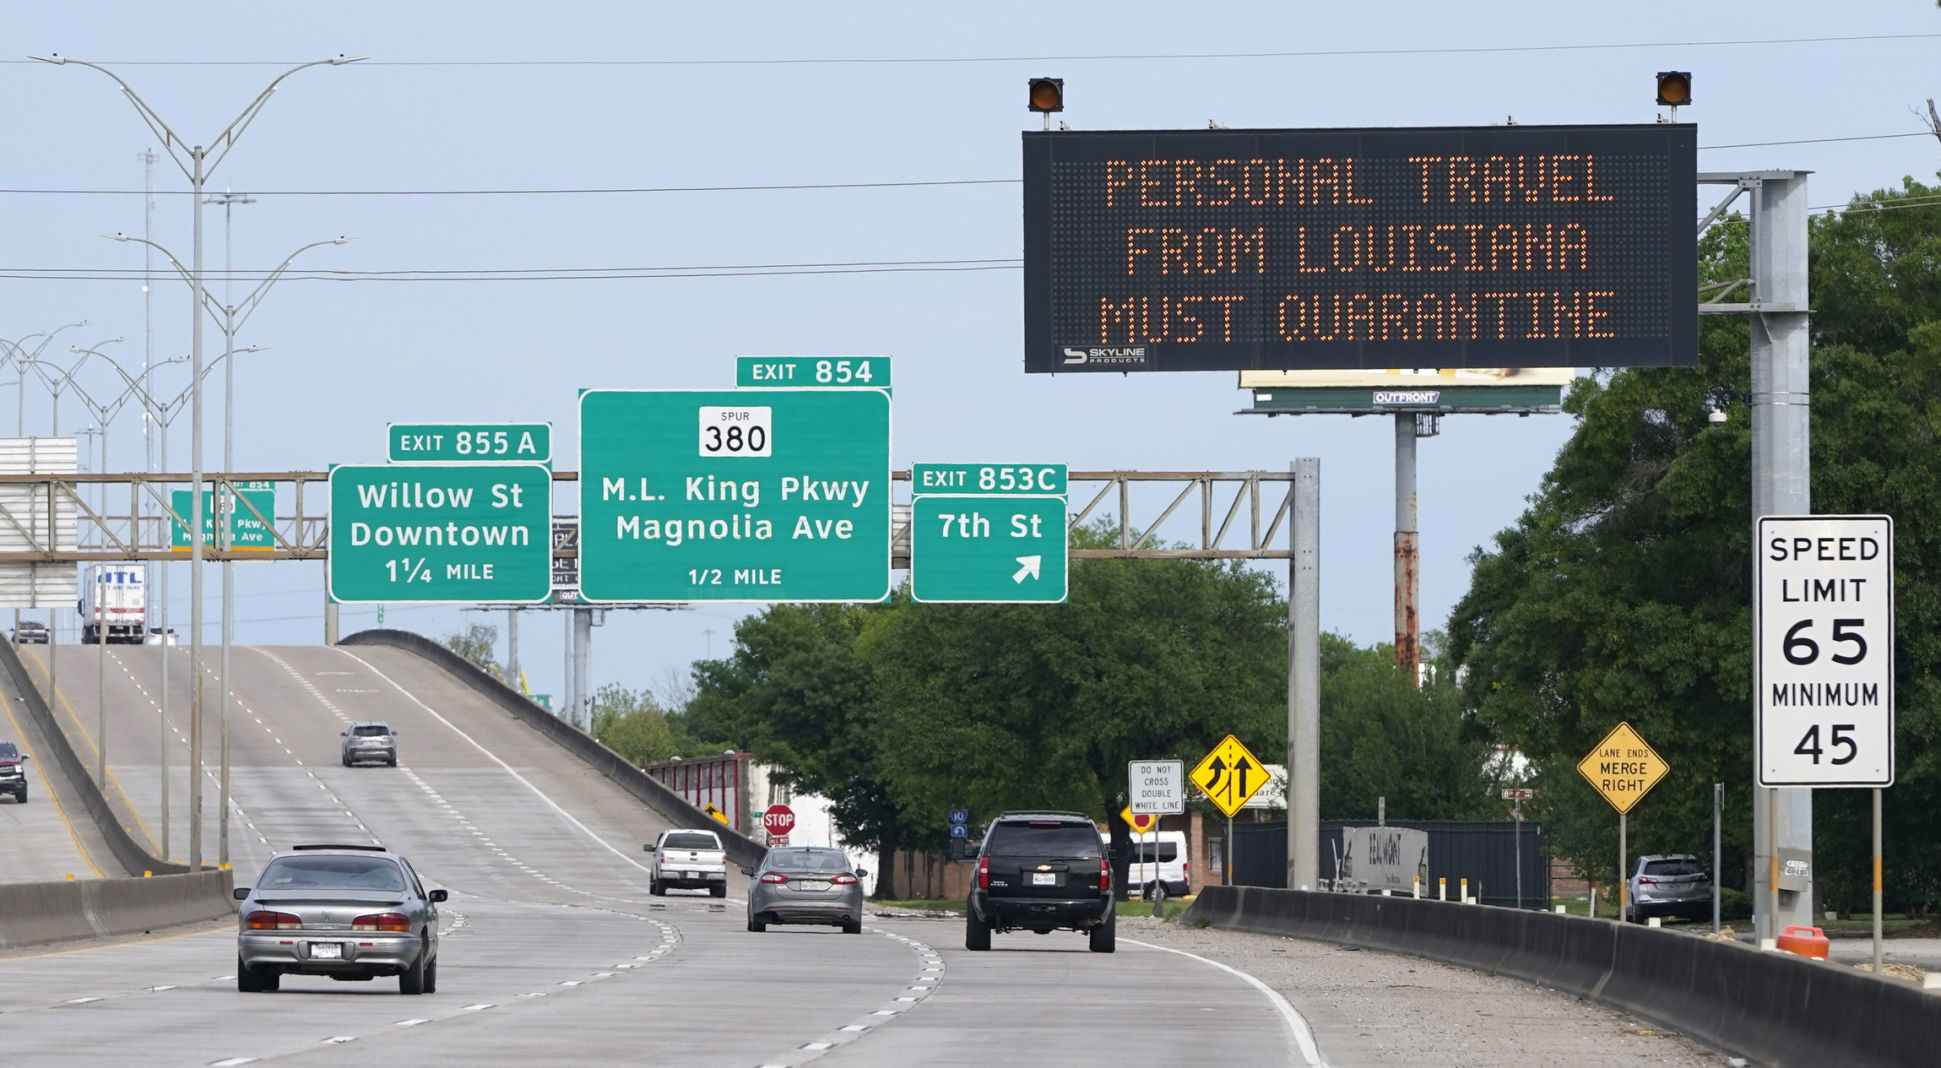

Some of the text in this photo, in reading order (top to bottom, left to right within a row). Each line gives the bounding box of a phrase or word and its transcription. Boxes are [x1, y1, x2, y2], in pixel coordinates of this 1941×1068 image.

[1107, 155, 1613, 206] PERSONAL TRAVEL
[1128, 224, 1586, 275] FROM LOUISIANA
[1101, 292, 1614, 343] MUST QUARANTINE
[1089, 347, 1145, 357] SKYLINE
[753, 361, 872, 382] EXIT 854
[1376, 391, 1436, 403] OUTFRONT
[722, 412, 749, 421] SPUR
[402, 432, 536, 454] EXIT 855 A
[706, 426, 765, 451] 380
[924, 468, 1055, 490] EXIT 853C
[358, 482, 522, 508] Willow St
[603, 475, 869, 507] M.L. King Pkwy
[352, 522, 528, 546] Downtown
[617, 514, 852, 546] Magnolia Ave
[939, 512, 1041, 537] 7th St
[241, 532, 262, 541] Ave
[1771, 538, 1878, 561] SPEED
[447, 564, 493, 579] MILE
[689, 569, 781, 584] 1/2 MILE
[1783, 579, 1866, 602] LIMIT
[1783, 619, 1867, 665] 65
[1773, 683, 1877, 706] MINIMUM
[1599, 748, 1649, 758] LANE ENDS
[1794, 725, 1857, 765] 45
[1140, 766, 1171, 775] DO NOT
[1600, 762, 1647, 775] MERGE
[1144, 778, 1169, 787] CROSS
[1602, 779, 1645, 791] RIGHT
[1141, 790, 1171, 798] DOUBLE
[1135, 802, 1179, 810] WHITE LINE
[765, 814, 793, 827] STOP
